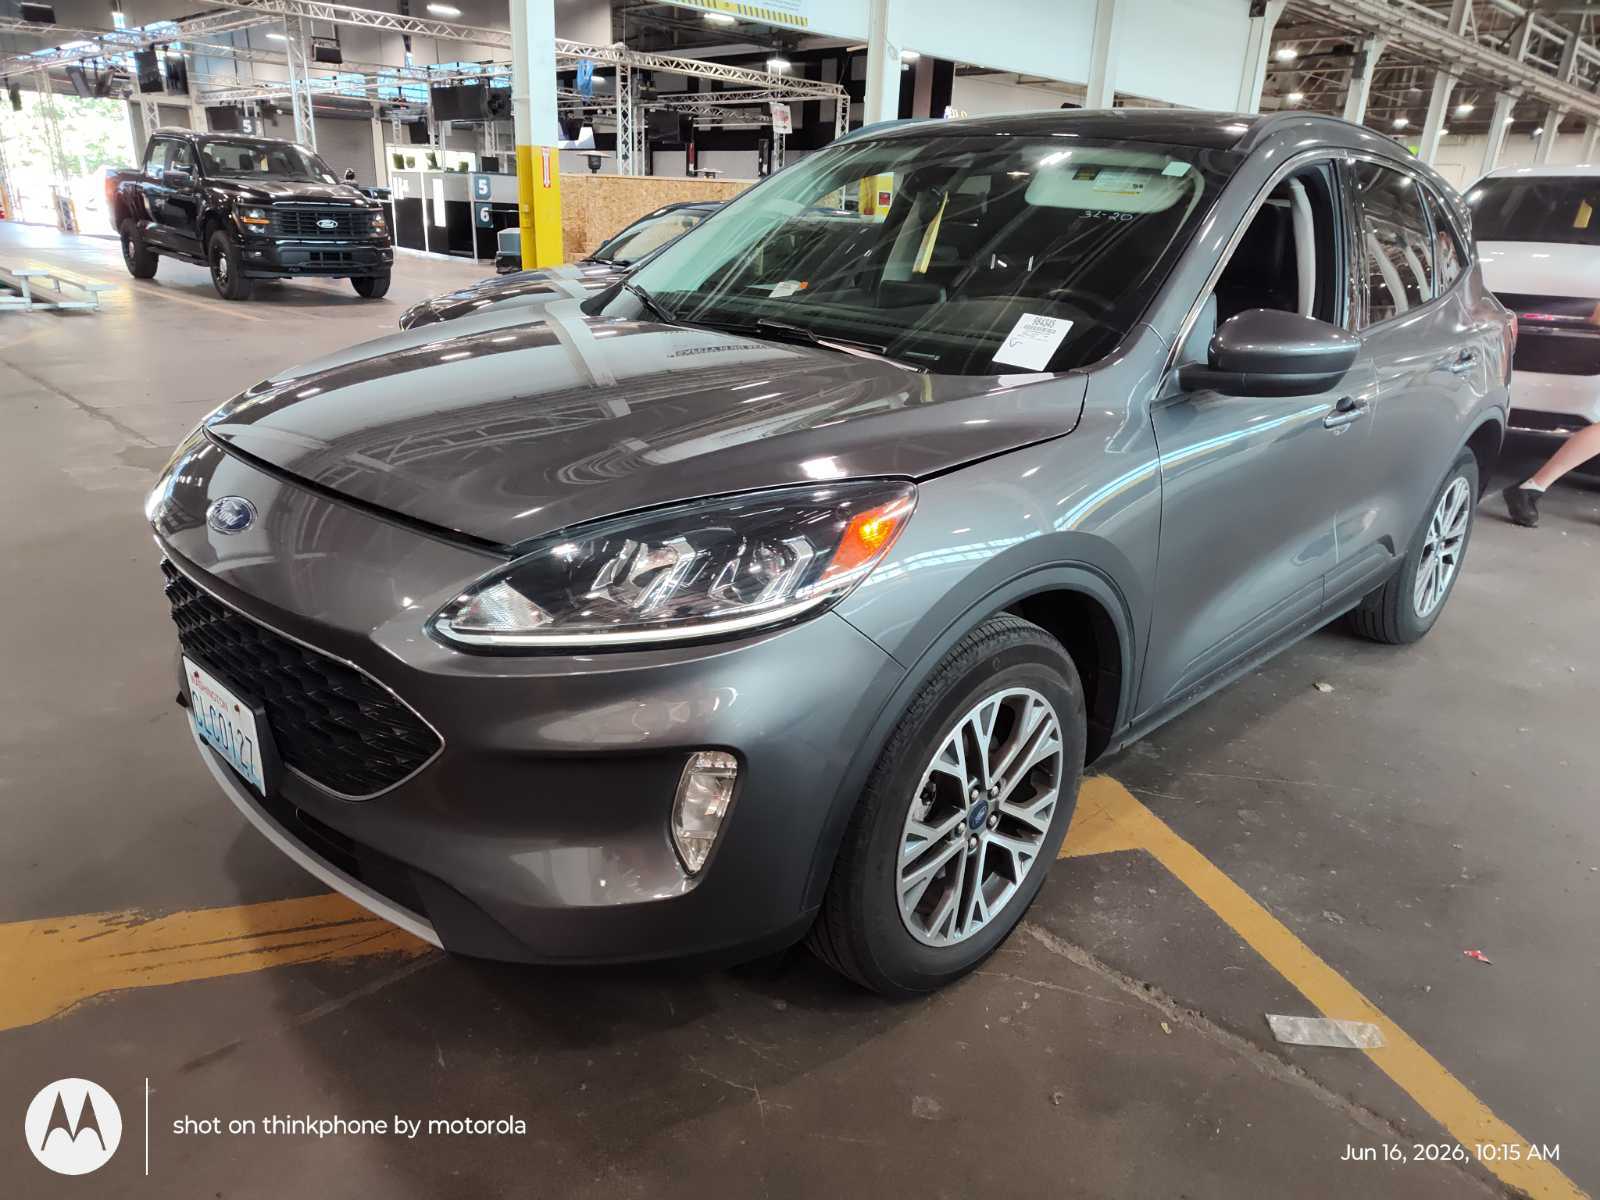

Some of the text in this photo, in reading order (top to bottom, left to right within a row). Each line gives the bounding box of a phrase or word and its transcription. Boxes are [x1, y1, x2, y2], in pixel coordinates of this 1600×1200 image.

[242, 119, 252, 133] 5
[478, 179, 488, 195] 5
[480, 206, 490, 222] 6
